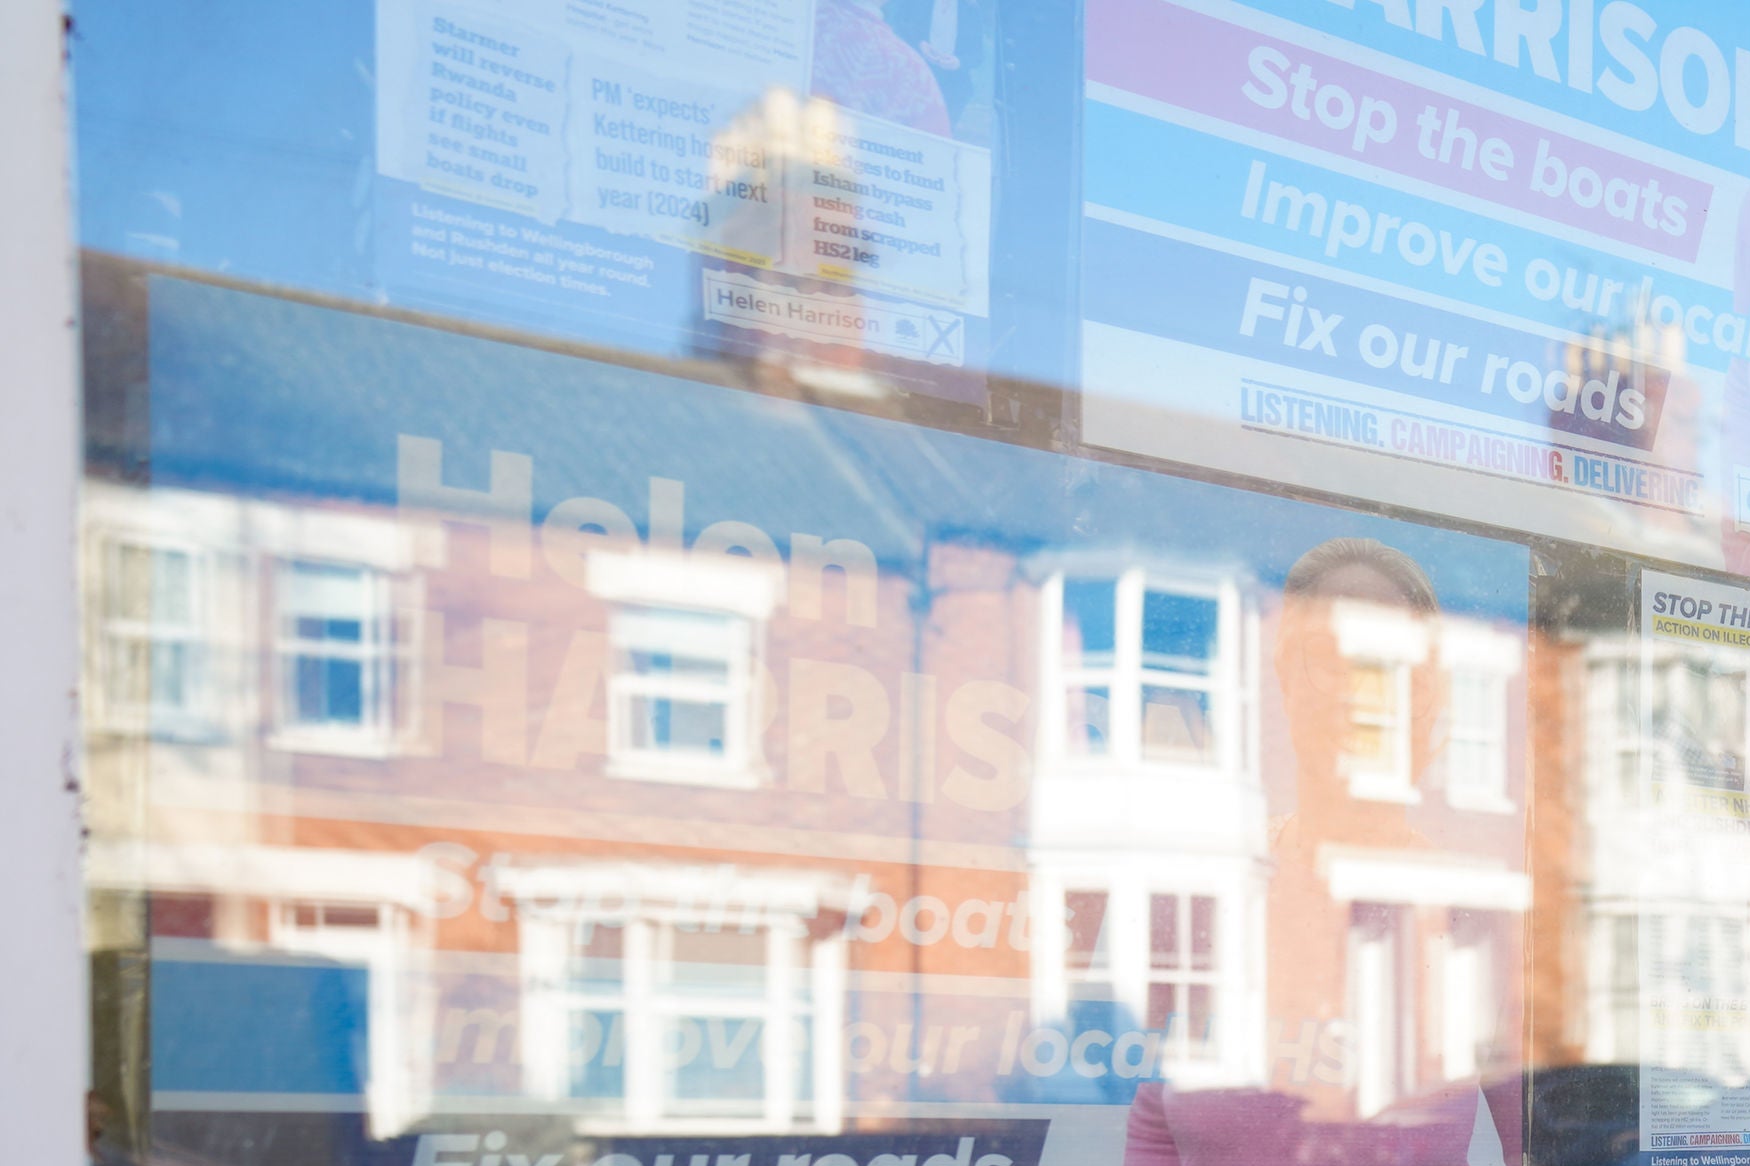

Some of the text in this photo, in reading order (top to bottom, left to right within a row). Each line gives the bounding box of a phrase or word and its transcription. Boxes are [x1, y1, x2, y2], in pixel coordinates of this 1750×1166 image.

[592, 78, 622, 105] PM
[594, 112, 766, 169] Kettering hospital
[1241, 45, 1688, 237] Stop the boats
[596, 148, 768, 203] build to start next
[597, 186, 710, 226] year (2024)
[1240, 159, 1508, 288] Improve
[1524, 257, 1623, 318] our
[716, 288, 880, 333] Helen Harrison
[1238, 276, 1647, 431] Fix our roads
[1240, 386, 1704, 514] LISTENING. CAMPAIGNING. DELIVERING.
[397, 431, 880, 629] Helen
[1653, 592, 1712, 620] STOP
[1655, 620, 1699, 638] ACTION
[1703, 628, 1720, 642] ON
[845, 873, 1075, 953] boats
[841, 1018, 980, 1075] our
[997, 1009, 1180, 1080] loca
[1651, 1134, 1688, 1147] LISTENING.
[1690, 1134, 1742, 1146] CAMPAIGNING.
[1690, 1156, 1699, 1166] to
